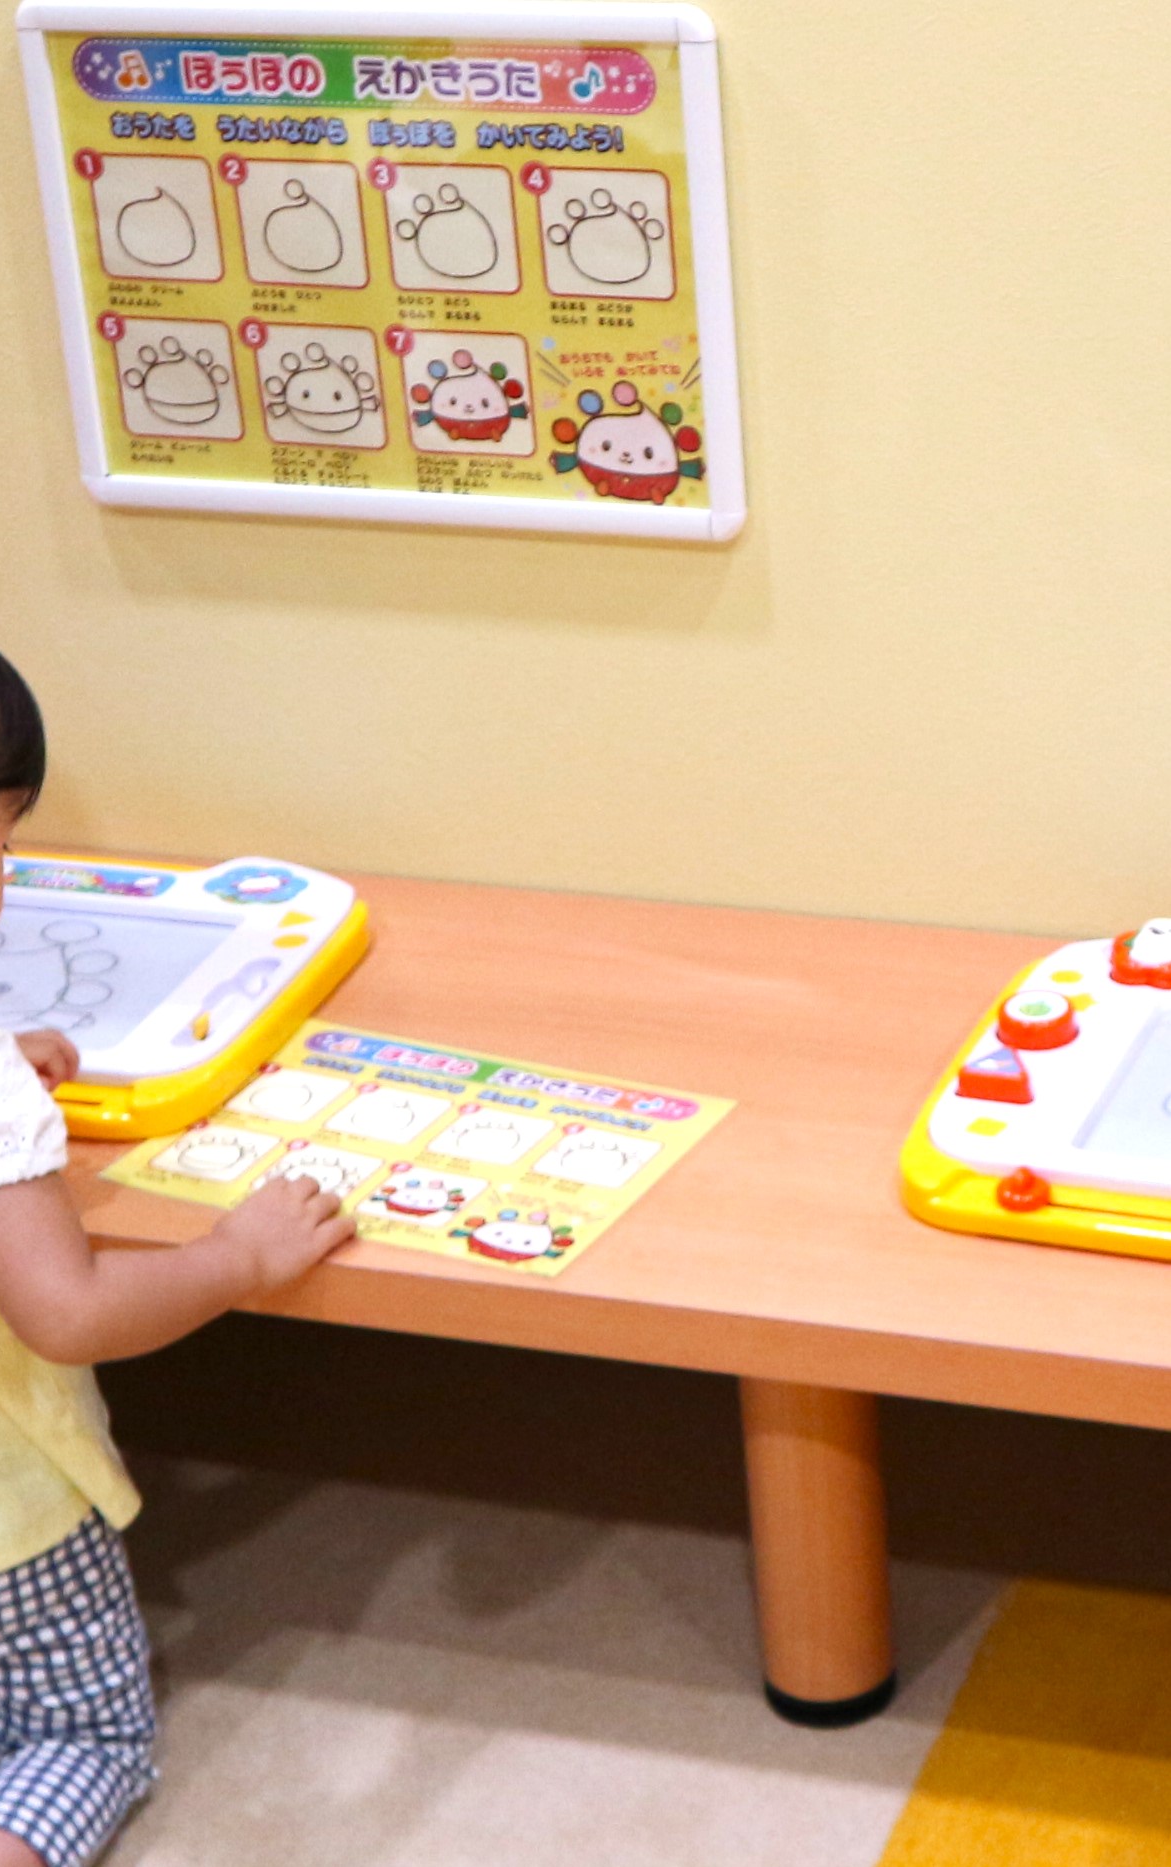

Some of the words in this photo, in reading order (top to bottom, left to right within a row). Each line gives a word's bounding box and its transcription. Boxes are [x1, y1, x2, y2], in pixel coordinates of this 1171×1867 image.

[357, 58, 540, 100] えかきうた
[111, 111, 195, 140] おうたを
[217, 113, 347, 144] うたいながら
